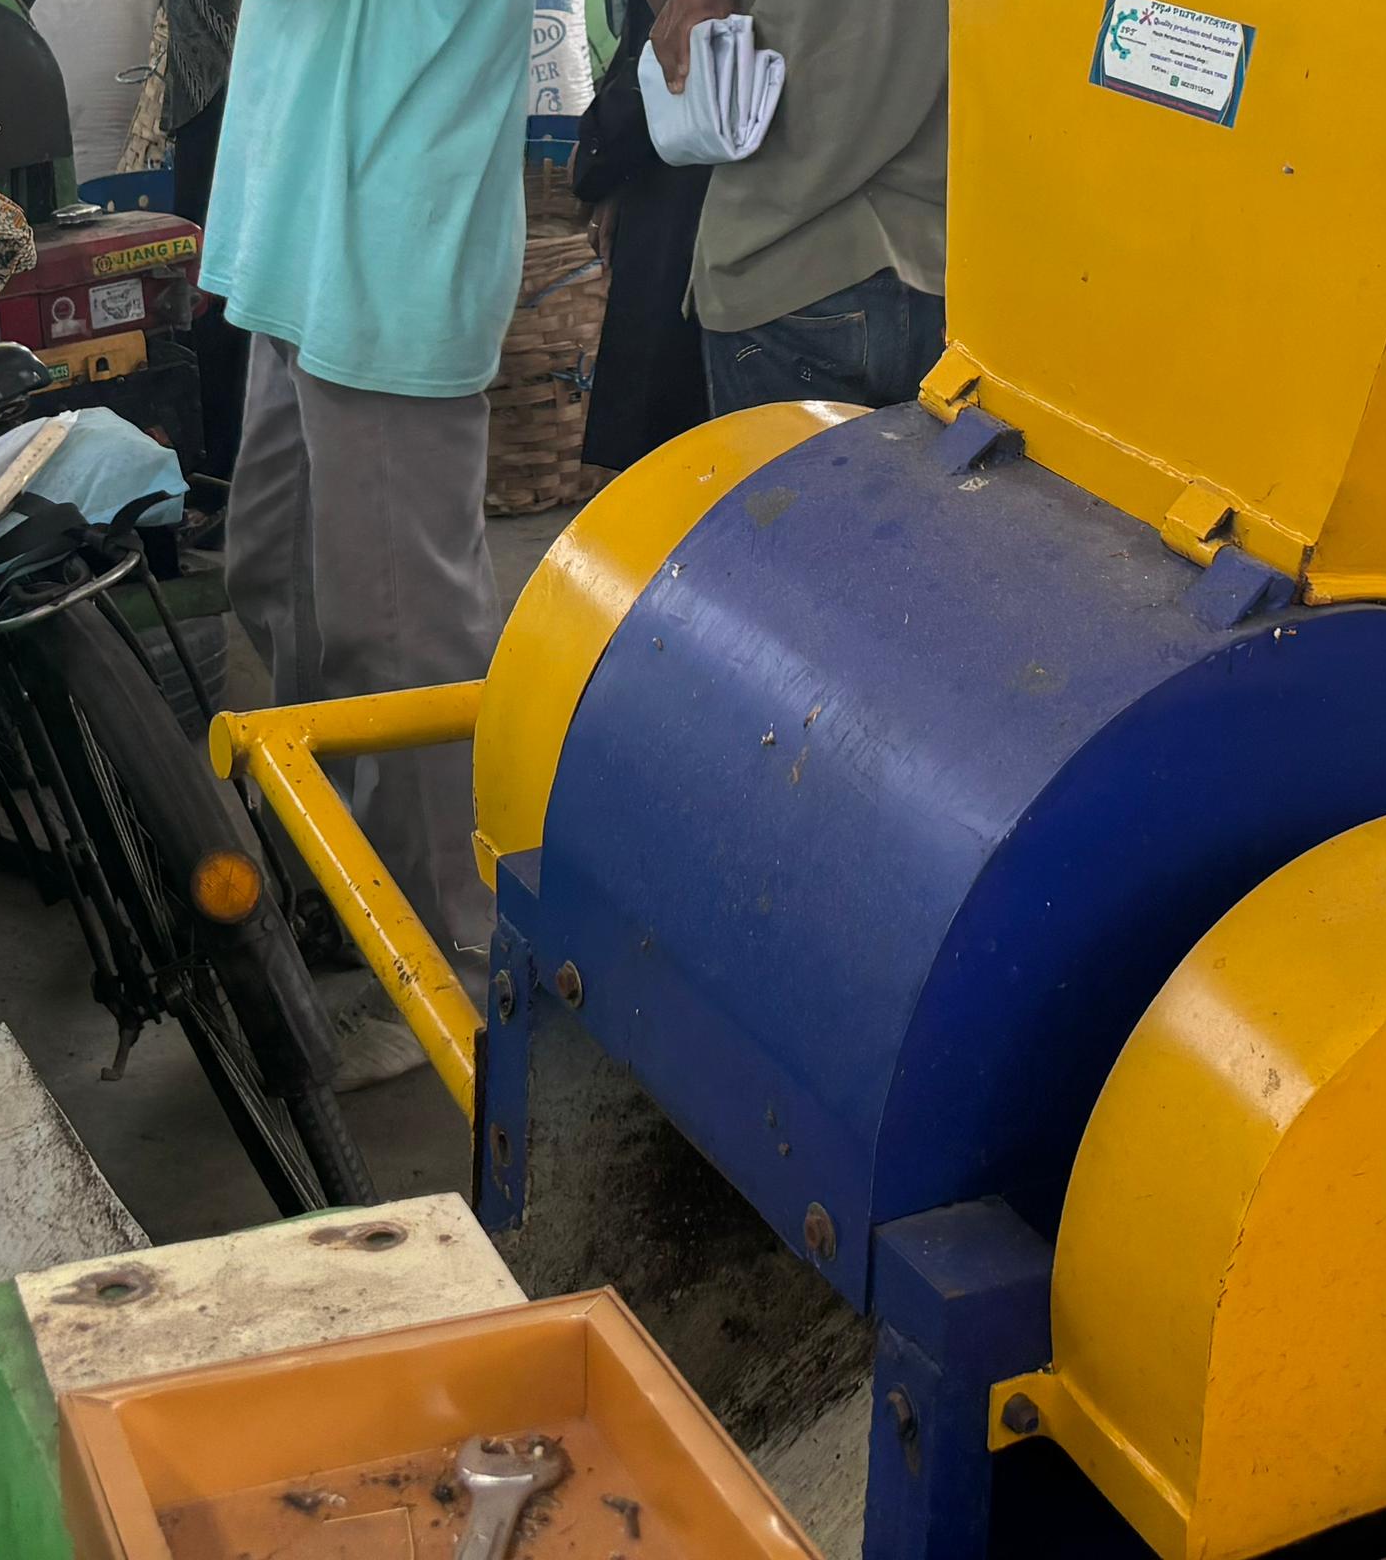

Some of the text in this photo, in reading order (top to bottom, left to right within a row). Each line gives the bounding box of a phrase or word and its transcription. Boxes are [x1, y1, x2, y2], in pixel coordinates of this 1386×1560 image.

[1154, 17, 1173, 30] Quality
[533, 24, 561, 45] DO
[531, 62, 560, 83] ER
[116, 239, 193, 265] JIANG FA
